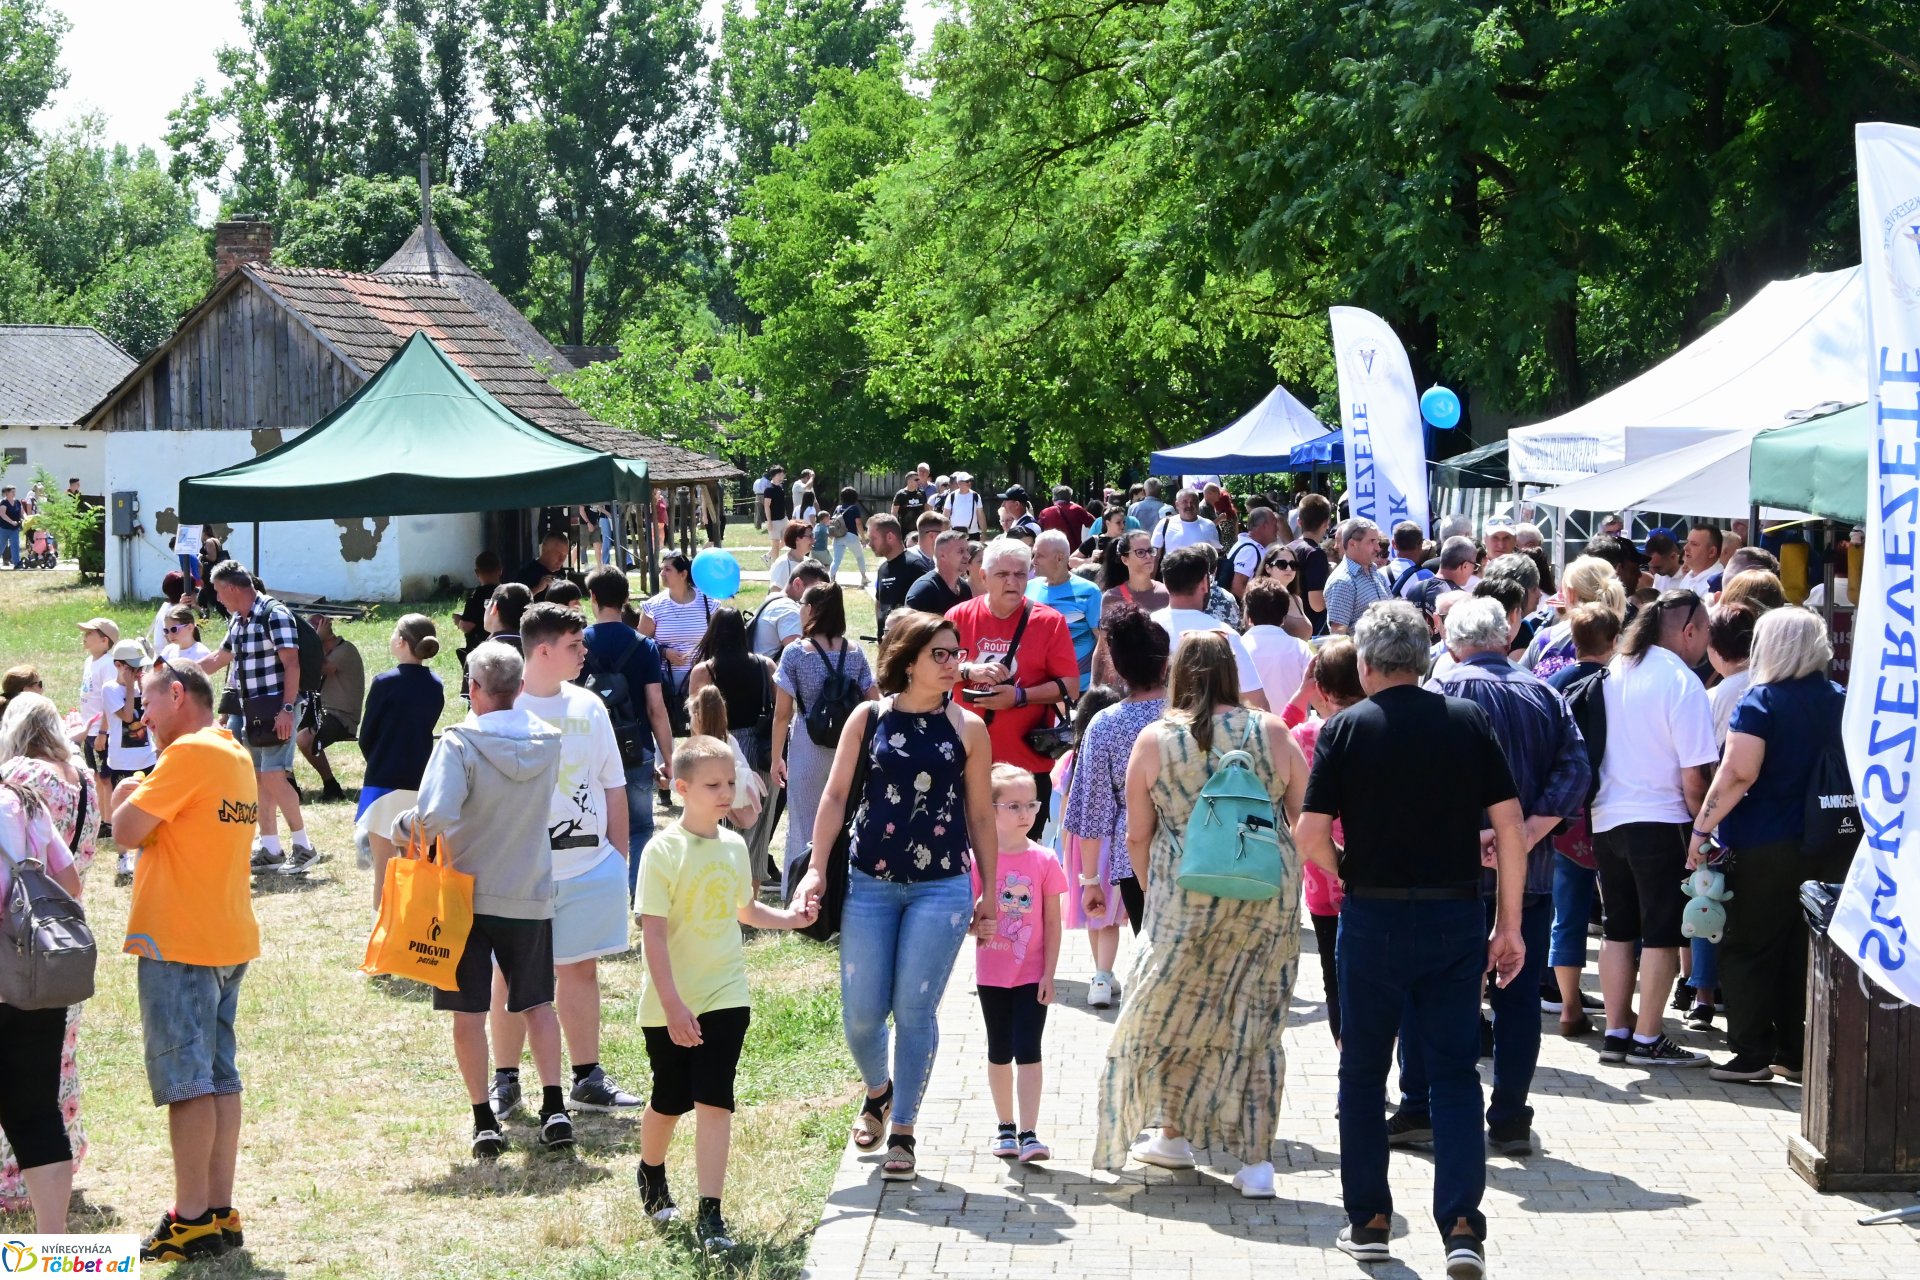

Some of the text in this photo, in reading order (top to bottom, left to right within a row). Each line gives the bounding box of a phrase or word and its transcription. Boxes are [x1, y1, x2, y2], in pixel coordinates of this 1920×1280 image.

[1817, 794, 1858, 809] TANKCSA
[408, 940, 450, 959] PINGVIN
[416, 956, 439, 966] patika
